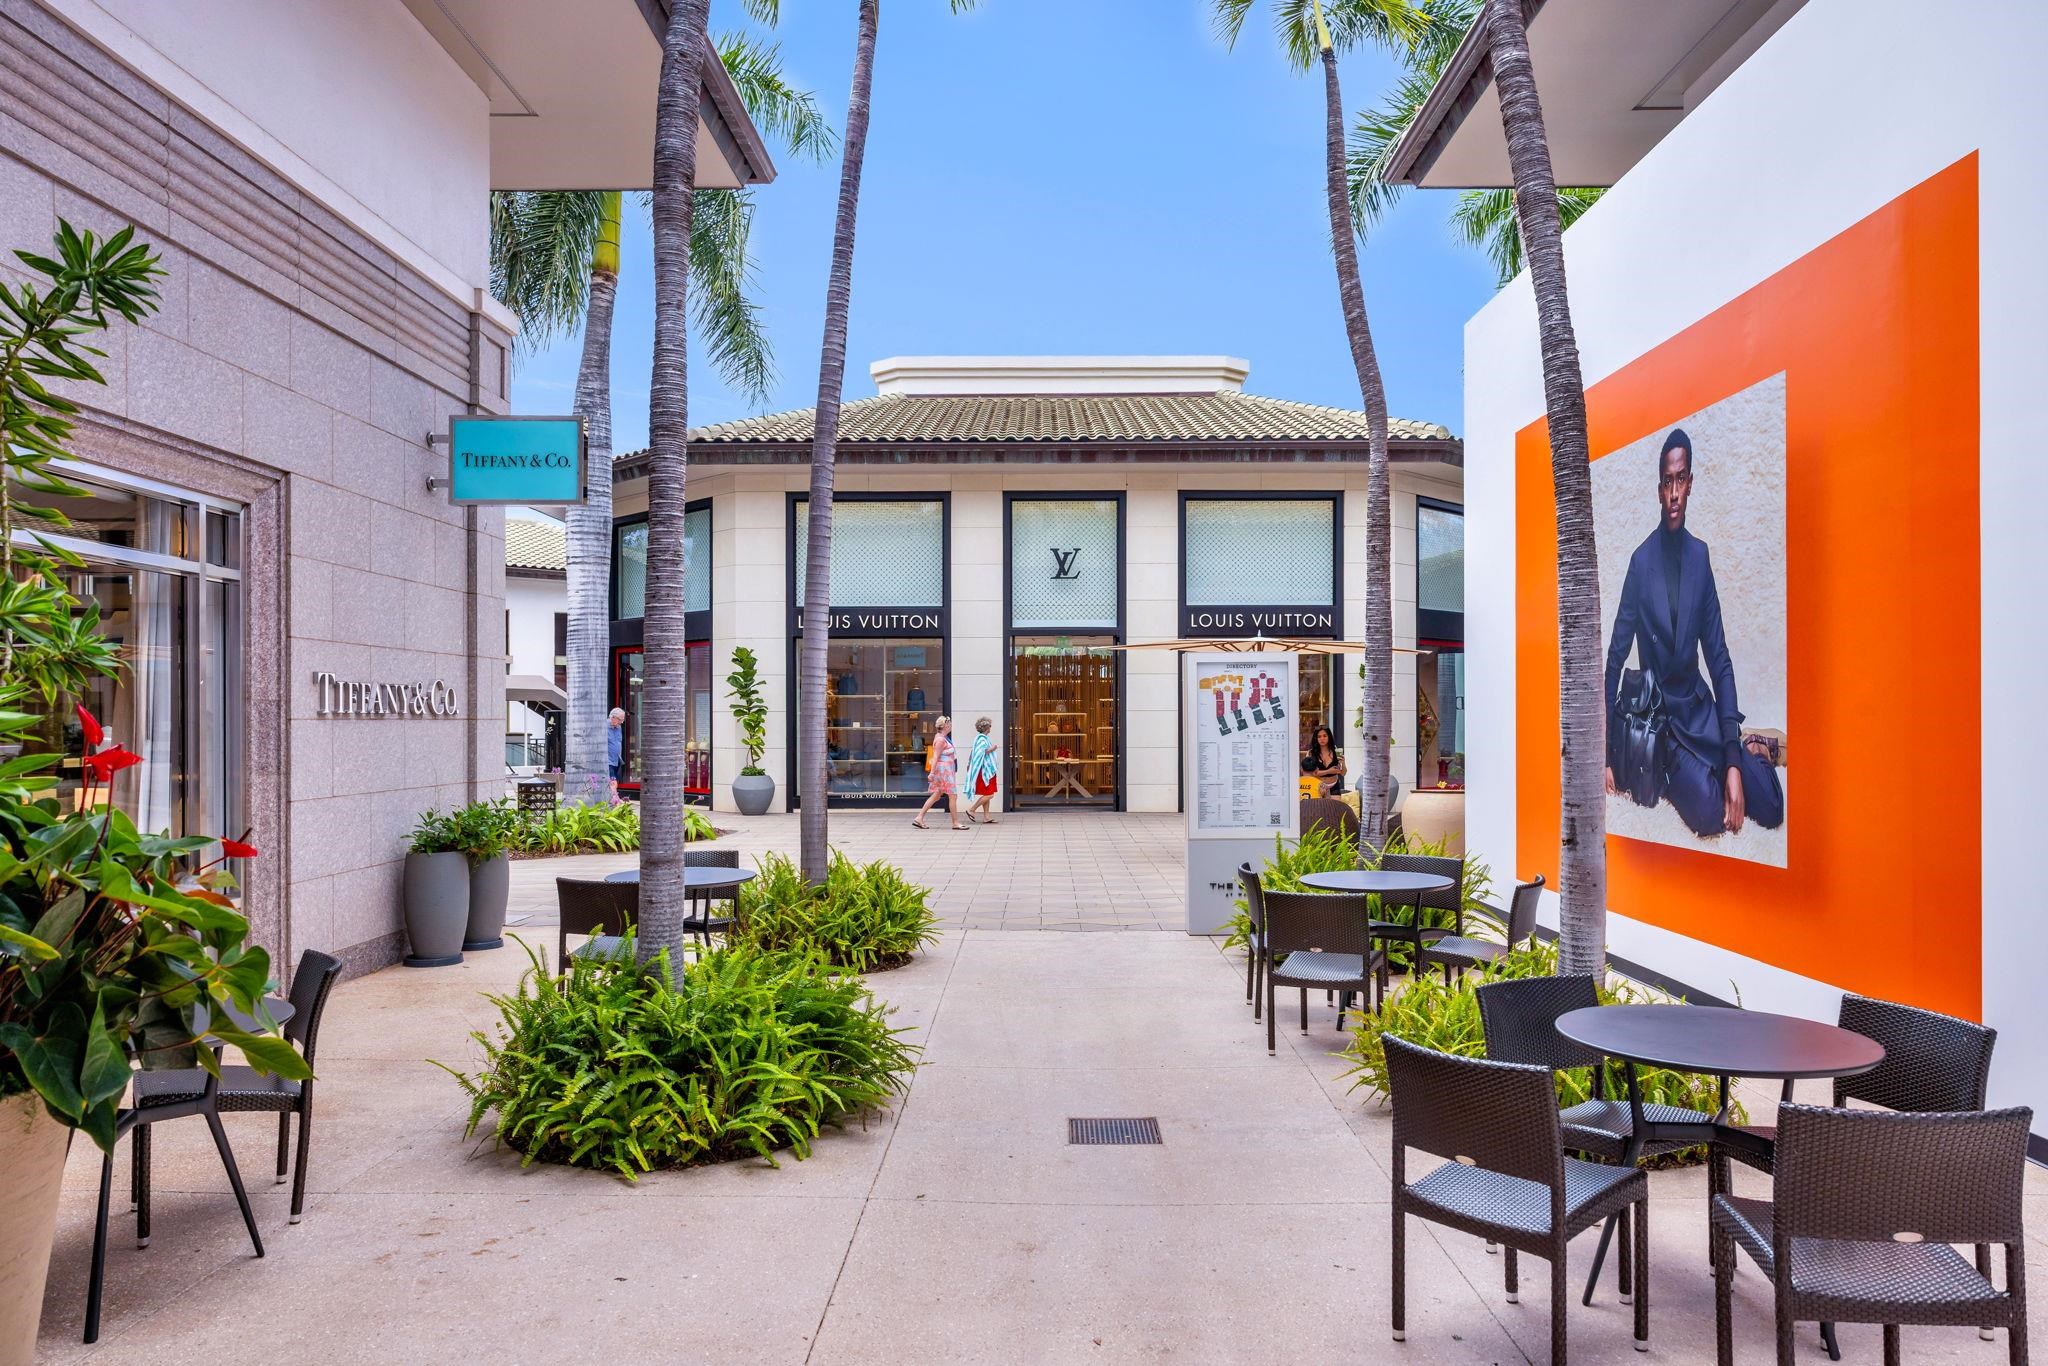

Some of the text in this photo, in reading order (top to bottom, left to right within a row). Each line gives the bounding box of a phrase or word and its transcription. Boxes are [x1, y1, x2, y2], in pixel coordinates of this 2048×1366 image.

[798, 615, 938, 629] LIS VUITTON
[1190, 613, 1332, 628] LOUIS VUITTON
[1209, 882, 1234, 890] THE
